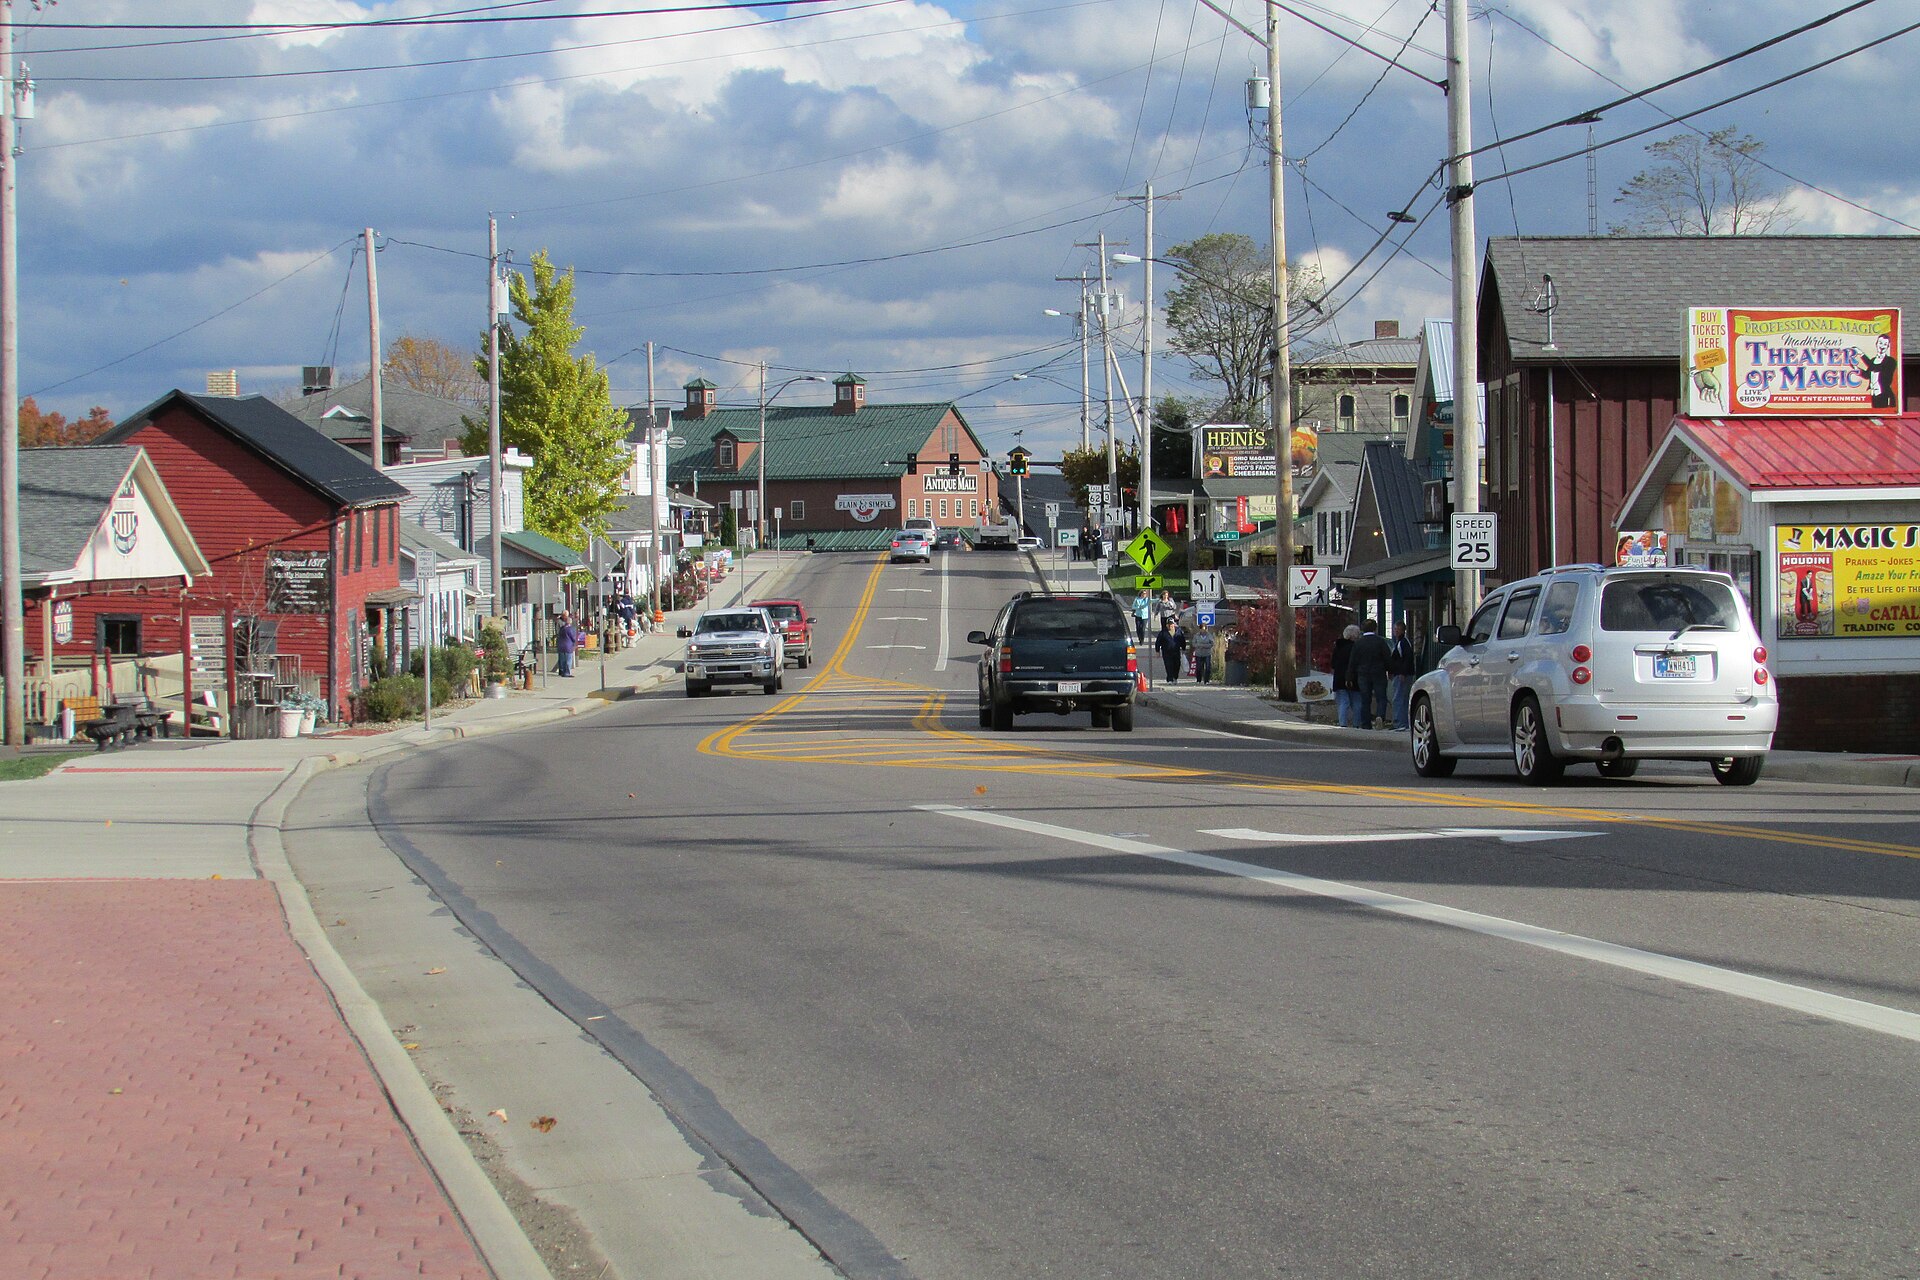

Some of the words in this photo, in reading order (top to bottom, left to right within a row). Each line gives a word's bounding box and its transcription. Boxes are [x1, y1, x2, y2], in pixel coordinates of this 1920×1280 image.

[1701, 312, 1717, 322] BUY
[1692, 325, 1726, 335] TICKETS
[1744, 319, 1837, 334] PROFESSIONAL
[1837, 321, 1880, 334] MAGIC
[1698, 338, 1720, 348] HERE
[1745, 340, 1859, 366] THEATER
[1745, 370, 1776, 390] OF
[1780, 366, 1862, 391] MAGIC
[926, 476, 956, 492] ANTIQUE
[958, 476, 976, 490] MALL
[1456, 520, 1492, 528] SPEED
[1460, 532, 1488, 540] LIMIT
[1812, 527, 1896, 549] MAGIC
[1457, 542, 1490, 562] 25
[308, 559, 327, 567] 1817
[1782, 557, 1830, 565] HOUDINI
[1845, 558, 1878, 566] PRANKS
[1888, 558, 1913, 566] JOKES
[1856, 570, 1884, 580] Amaze
[1888, 570, 1907, 580] Your
[1842, 624, 1895, 632] TRADING
